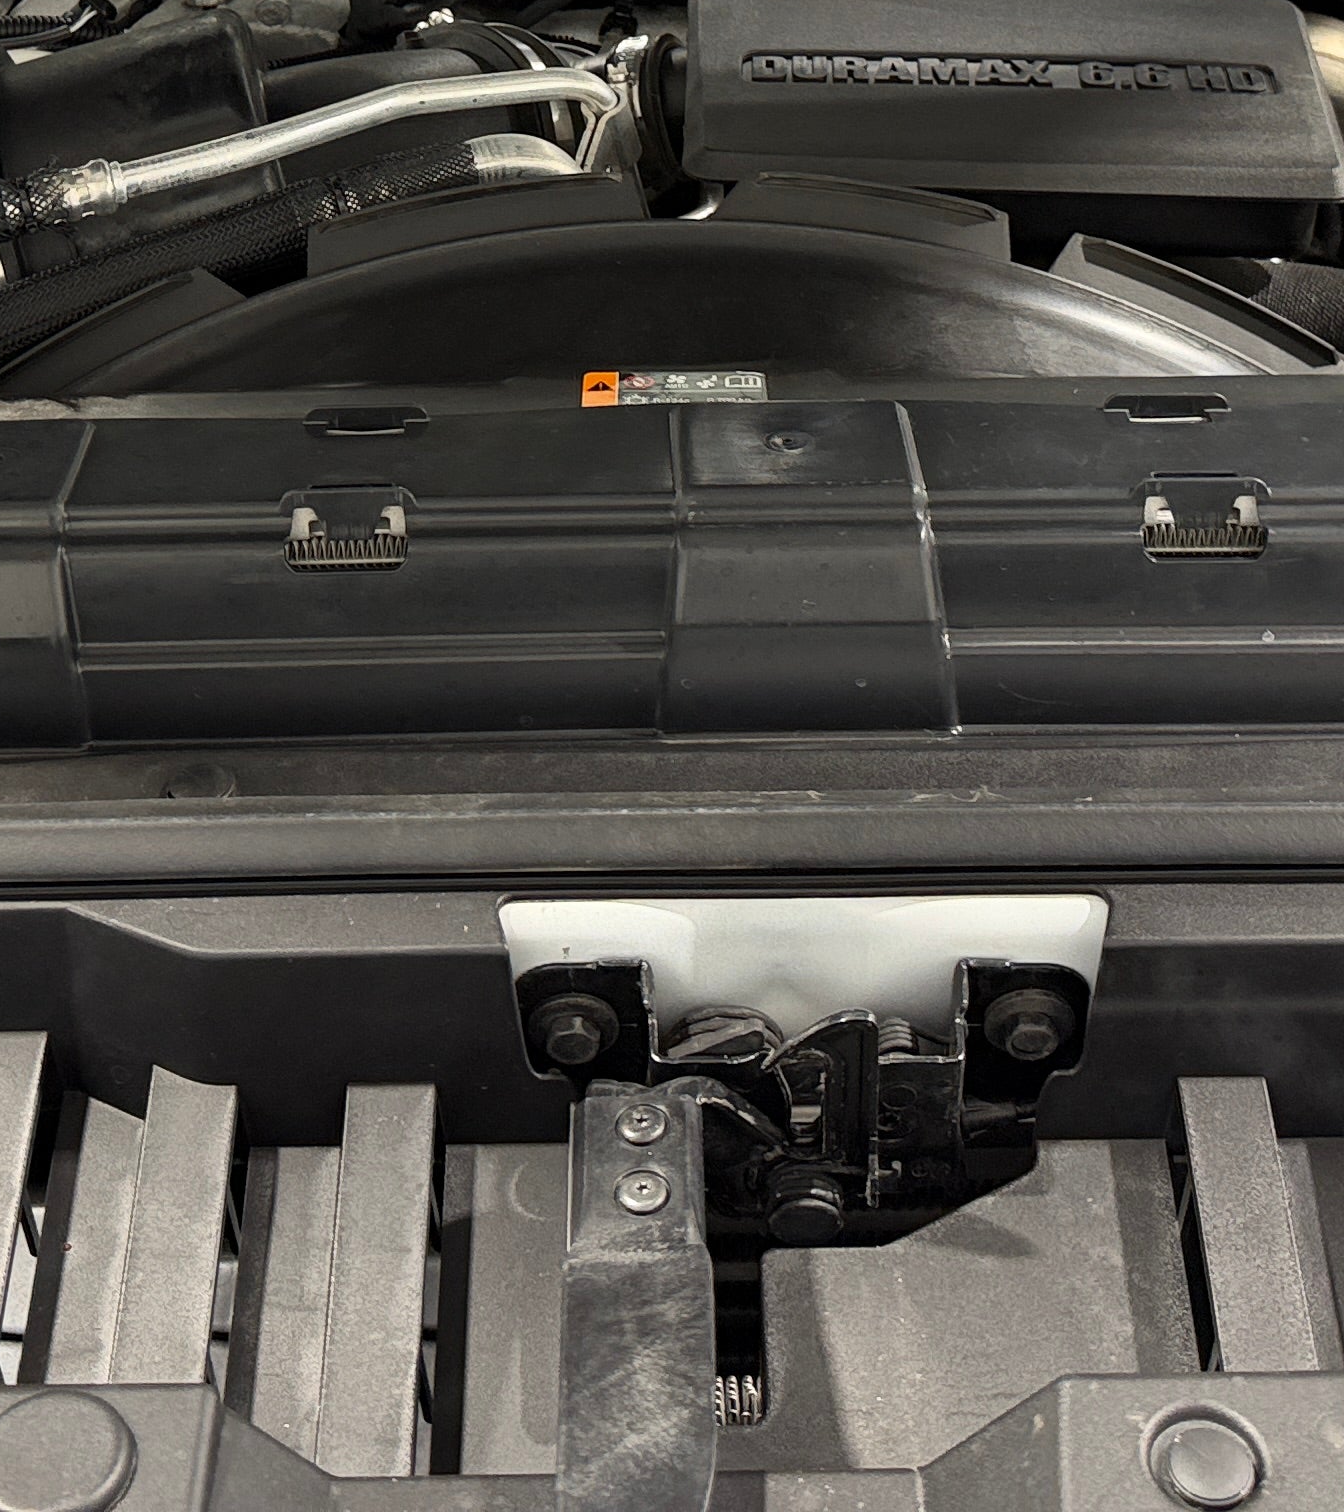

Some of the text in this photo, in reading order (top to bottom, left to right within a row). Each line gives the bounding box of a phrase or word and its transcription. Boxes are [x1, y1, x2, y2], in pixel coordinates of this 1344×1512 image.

[751, 55, 1271, 92] DURAMAX 6.6 HD
